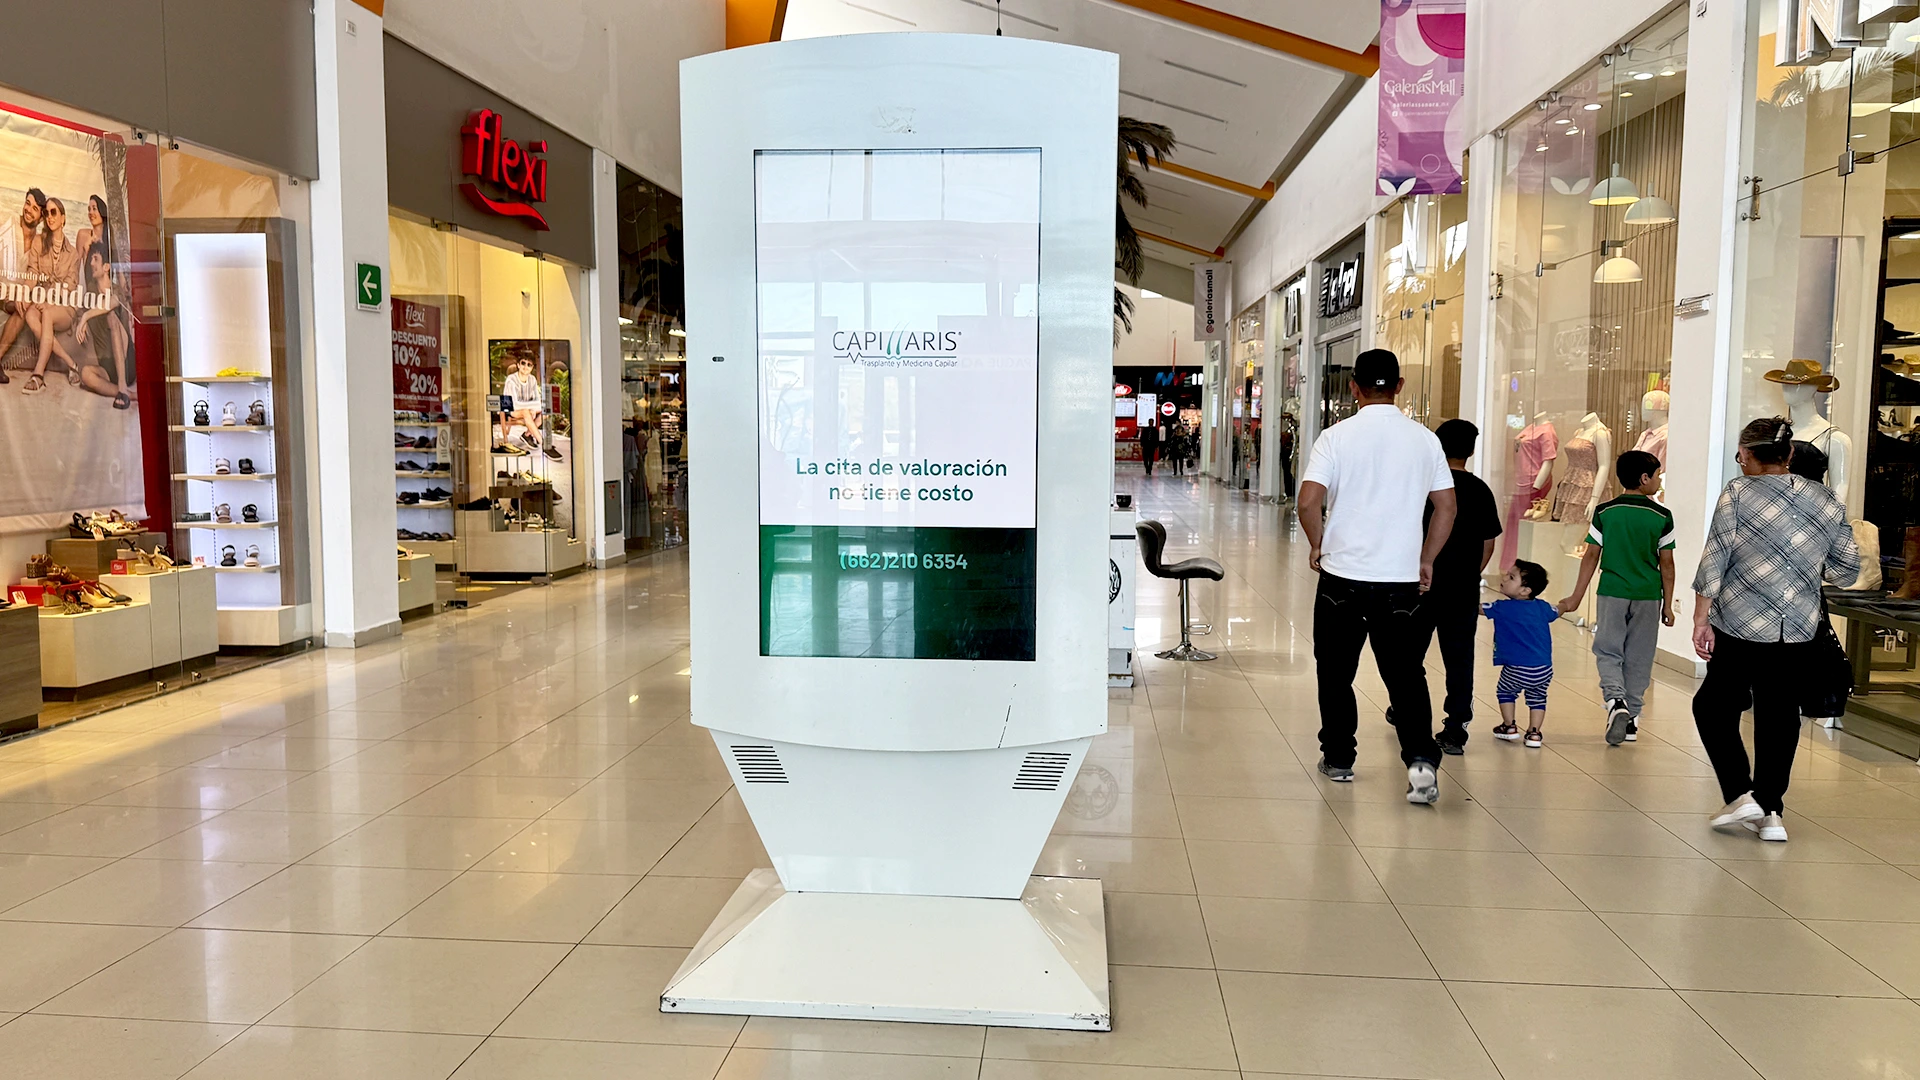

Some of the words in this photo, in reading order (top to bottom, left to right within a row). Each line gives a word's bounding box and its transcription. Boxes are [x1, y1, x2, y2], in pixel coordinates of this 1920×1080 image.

[466, 108, 548, 203] flexi
[405, 305, 426, 322] flexi
[392, 330, 437, 349] DESCUENTO
[393, 344, 421, 367] 10%
[860, 360, 895, 368] Trasplante
[934, 360, 958, 368] Capilar
[405, 369, 411, 379] Y
[410, 374, 438, 395] 20%
[796, 458, 818, 475] La
[825, 458, 862, 475] cita
[868, 459, 894, 475] de
[900, 459, 1008, 477] valoración
[829, 486, 854, 500] no
[862, 483, 911, 501] tiene
[918, 484, 974, 501] costo
[839, 551, 918, 571] (662)210
[922, 553, 968, 570] 6354
